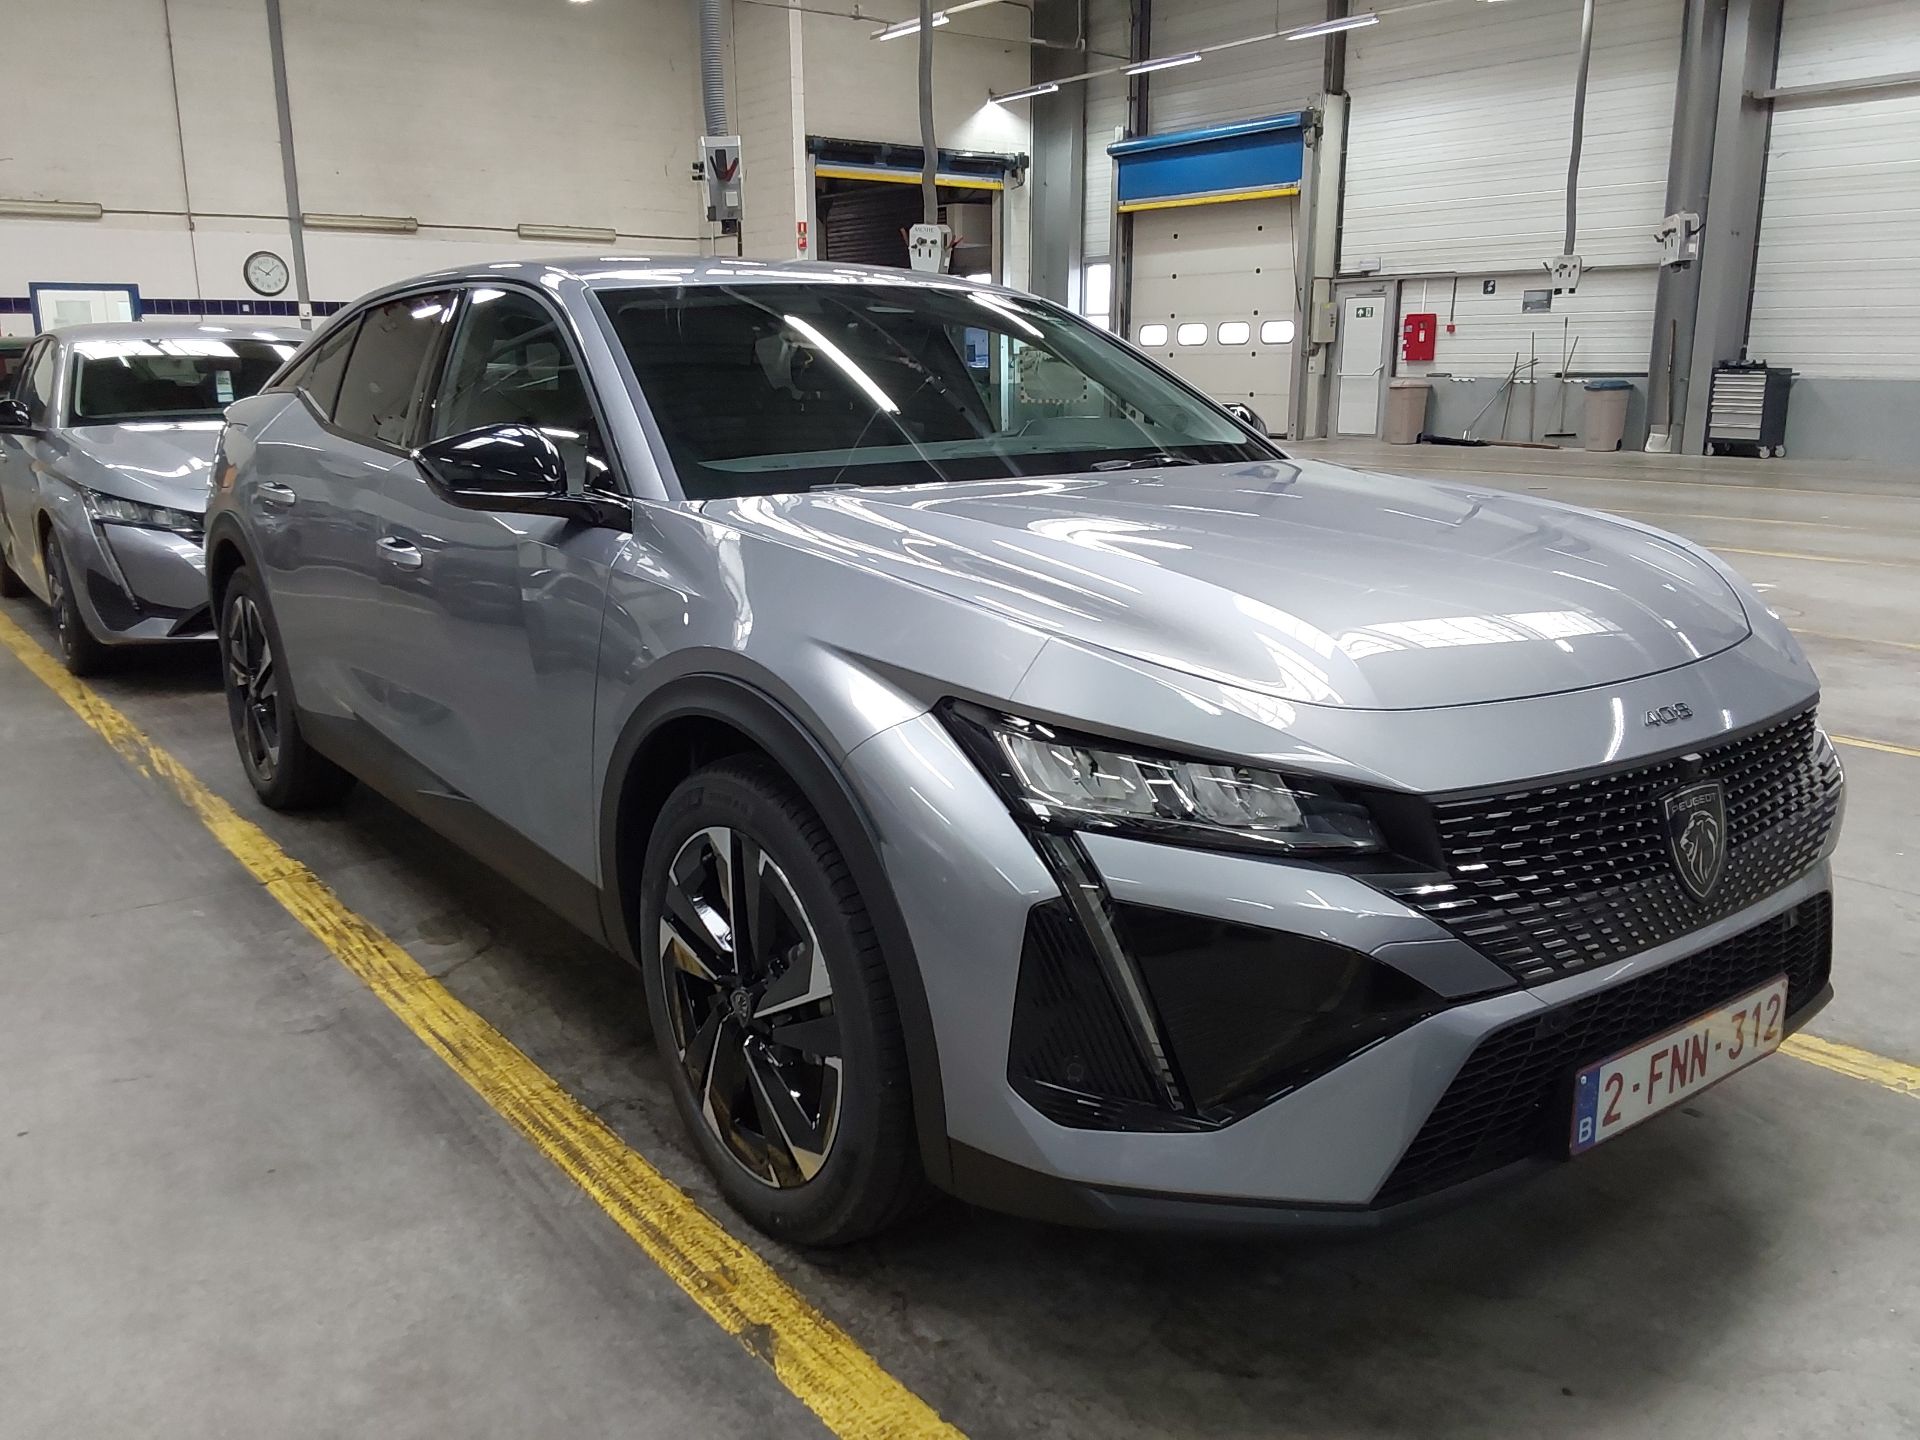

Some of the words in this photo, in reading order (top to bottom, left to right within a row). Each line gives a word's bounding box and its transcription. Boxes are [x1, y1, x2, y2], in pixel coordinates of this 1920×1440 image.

[1644, 702, 1693, 726] 408
[1671, 792, 1716, 814] PEUGEOT
[1602, 993, 1781, 1127] 2-FNN-312
[1578, 1115, 1592, 1143] B
